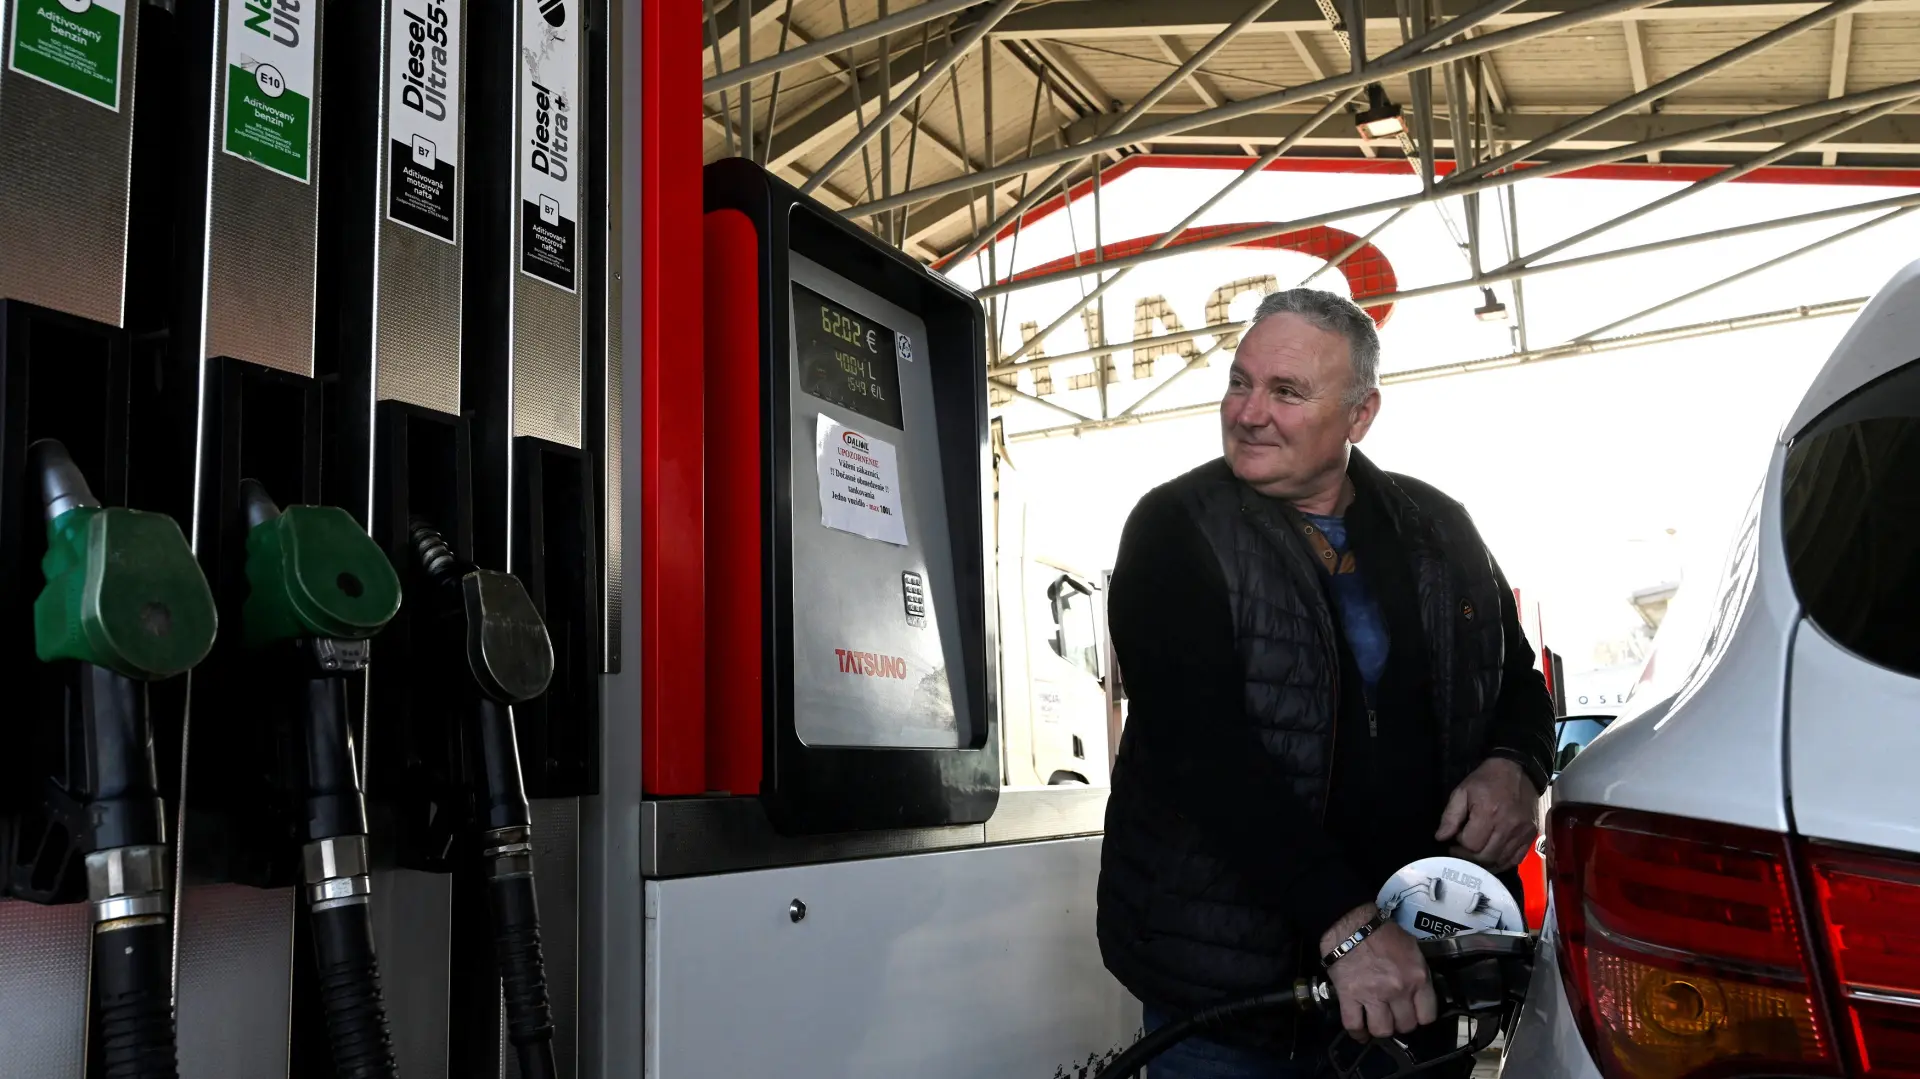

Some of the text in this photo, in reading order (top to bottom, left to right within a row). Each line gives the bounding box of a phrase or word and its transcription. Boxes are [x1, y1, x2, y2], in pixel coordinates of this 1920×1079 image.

[37, 7, 102, 42] Aditivovaný
[402, 9, 426, 113] Diesel
[260, 72, 281, 89] E10
[243, 95, 295, 123] Aditivovaný
[532, 81, 550, 175] Diesel
[551, 95, 568, 182] Ultra+
[418, 146, 430, 158] B7
[403, 166, 444, 190] Aditivovaná
[406, 177, 440, 196] motorová
[414, 187, 433, 200] nafta
[544, 204, 554, 216] B7
[532, 224, 567, 244] Aditivovaná
[535, 233, 563, 250] motorová
[541, 243, 557, 254] nafta
[866, 329, 877, 354] €
[868, 361, 876, 381] L
[870, 383, 885, 400] €/L
[838, 459, 856, 471] Vážení
[848, 486, 875, 500] tankovania
[857, 477, 885, 492] obmedzenie
[832, 491, 847, 502] Jedno
[869, 504, 879, 512] max
[835, 648, 907, 680] TATSUNO
[1442, 867, 1482, 889] HOLDER
